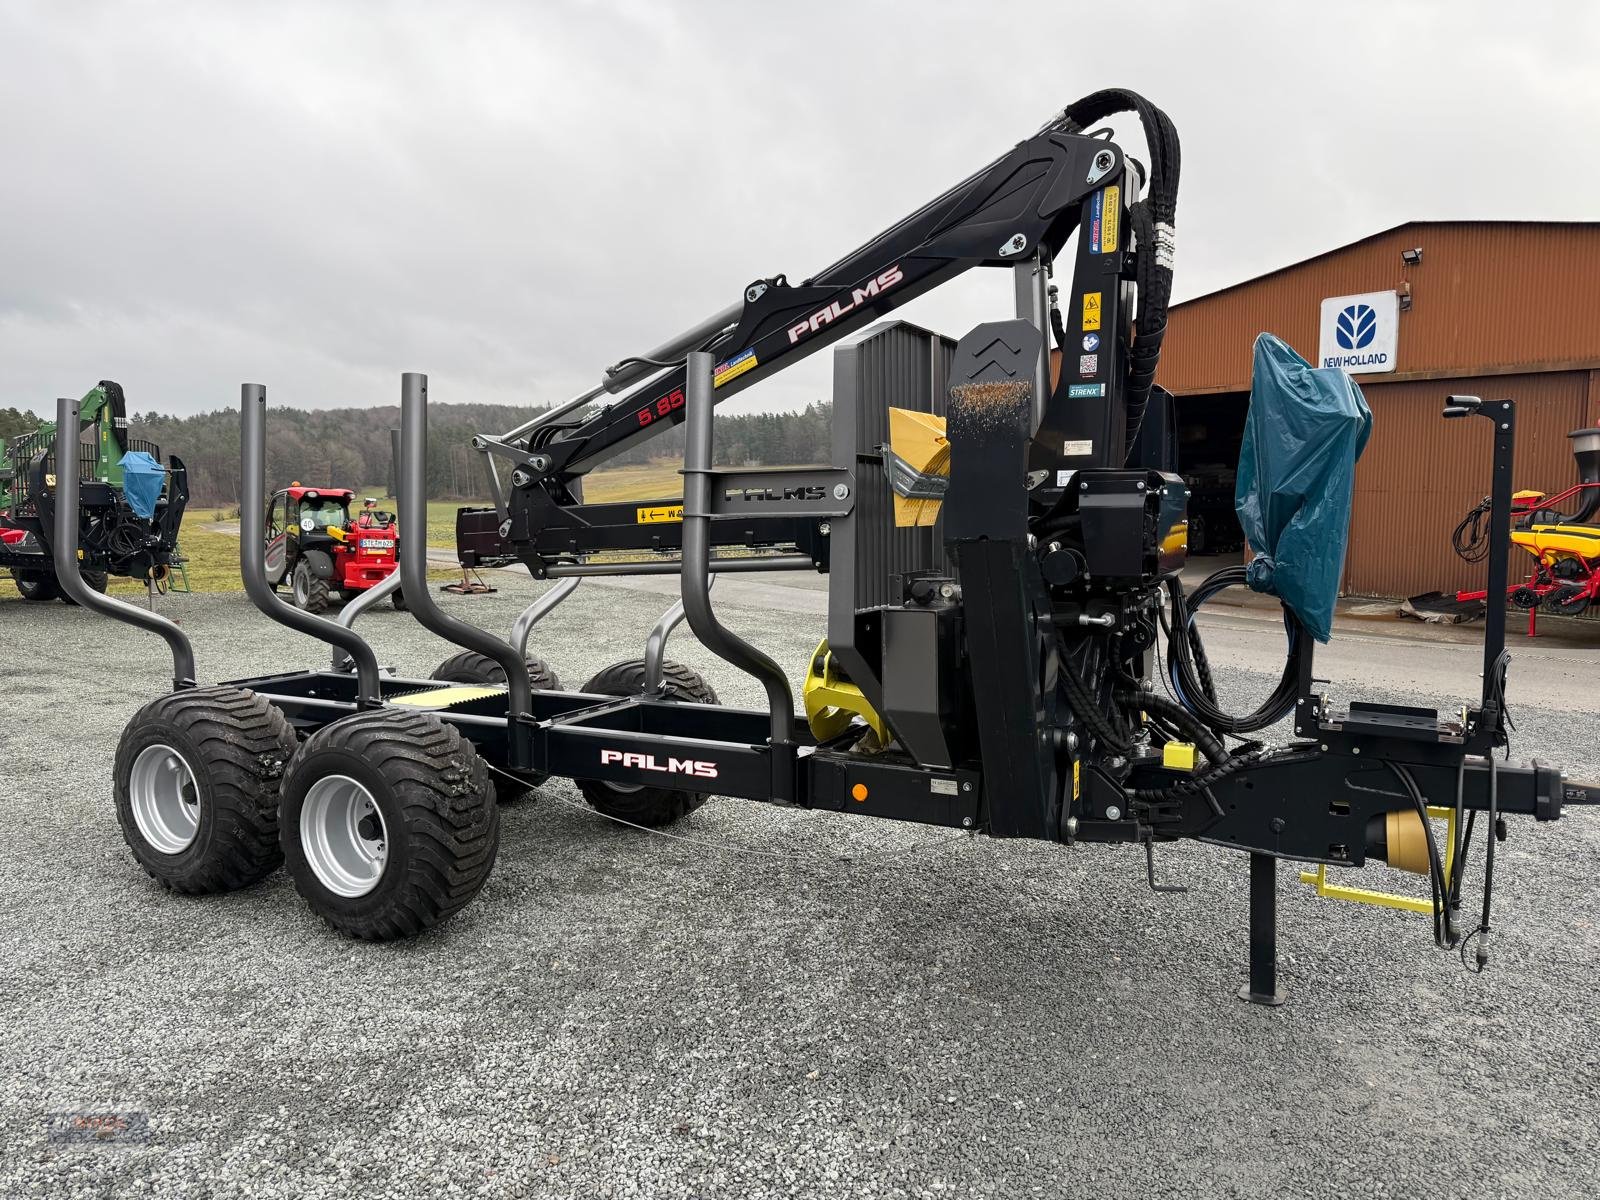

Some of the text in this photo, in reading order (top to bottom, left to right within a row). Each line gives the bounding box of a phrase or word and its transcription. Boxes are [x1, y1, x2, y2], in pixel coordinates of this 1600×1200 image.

[787, 264, 904, 344] PALMS
[1323, 353, 1388, 368] NEW HOLLAND
[1070, 388, 1097, 396] STRENX
[638, 389, 685, 427] 5.85
[724, 486, 827, 501] PALMS
[303, 520, 312, 530] 40
[600, 749, 719, 778] PALMS
